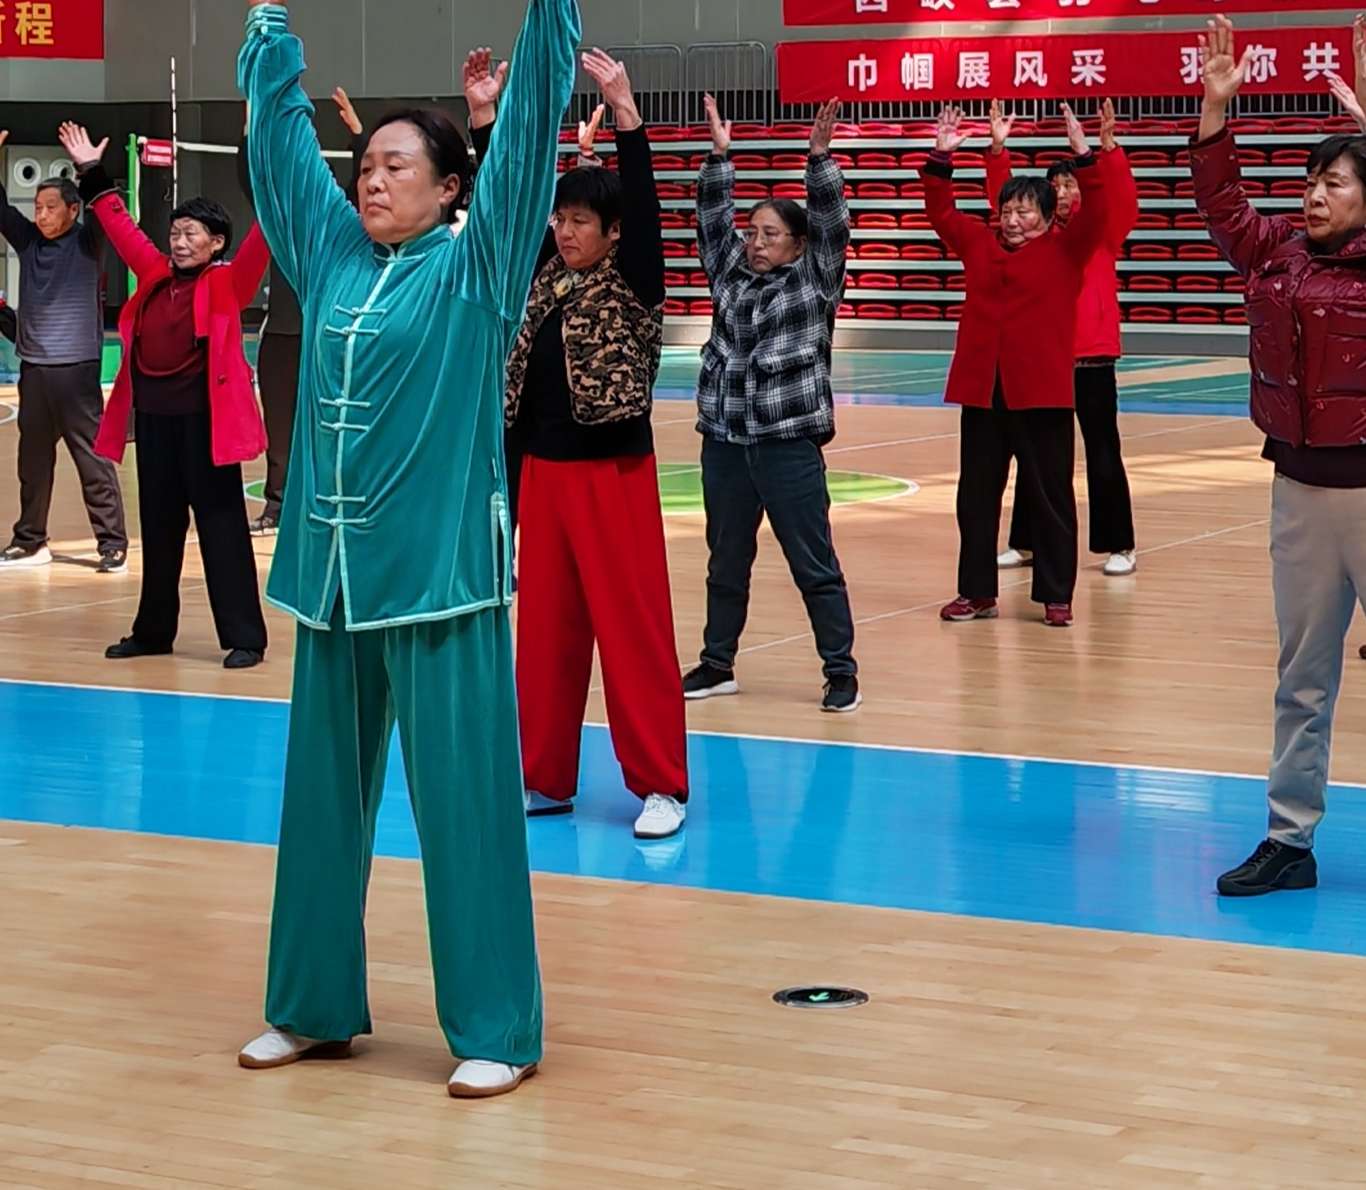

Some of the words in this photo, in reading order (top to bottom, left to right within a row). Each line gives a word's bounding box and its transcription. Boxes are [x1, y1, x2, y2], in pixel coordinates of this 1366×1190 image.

[847, 48, 1107, 92] 巾帼展风采
